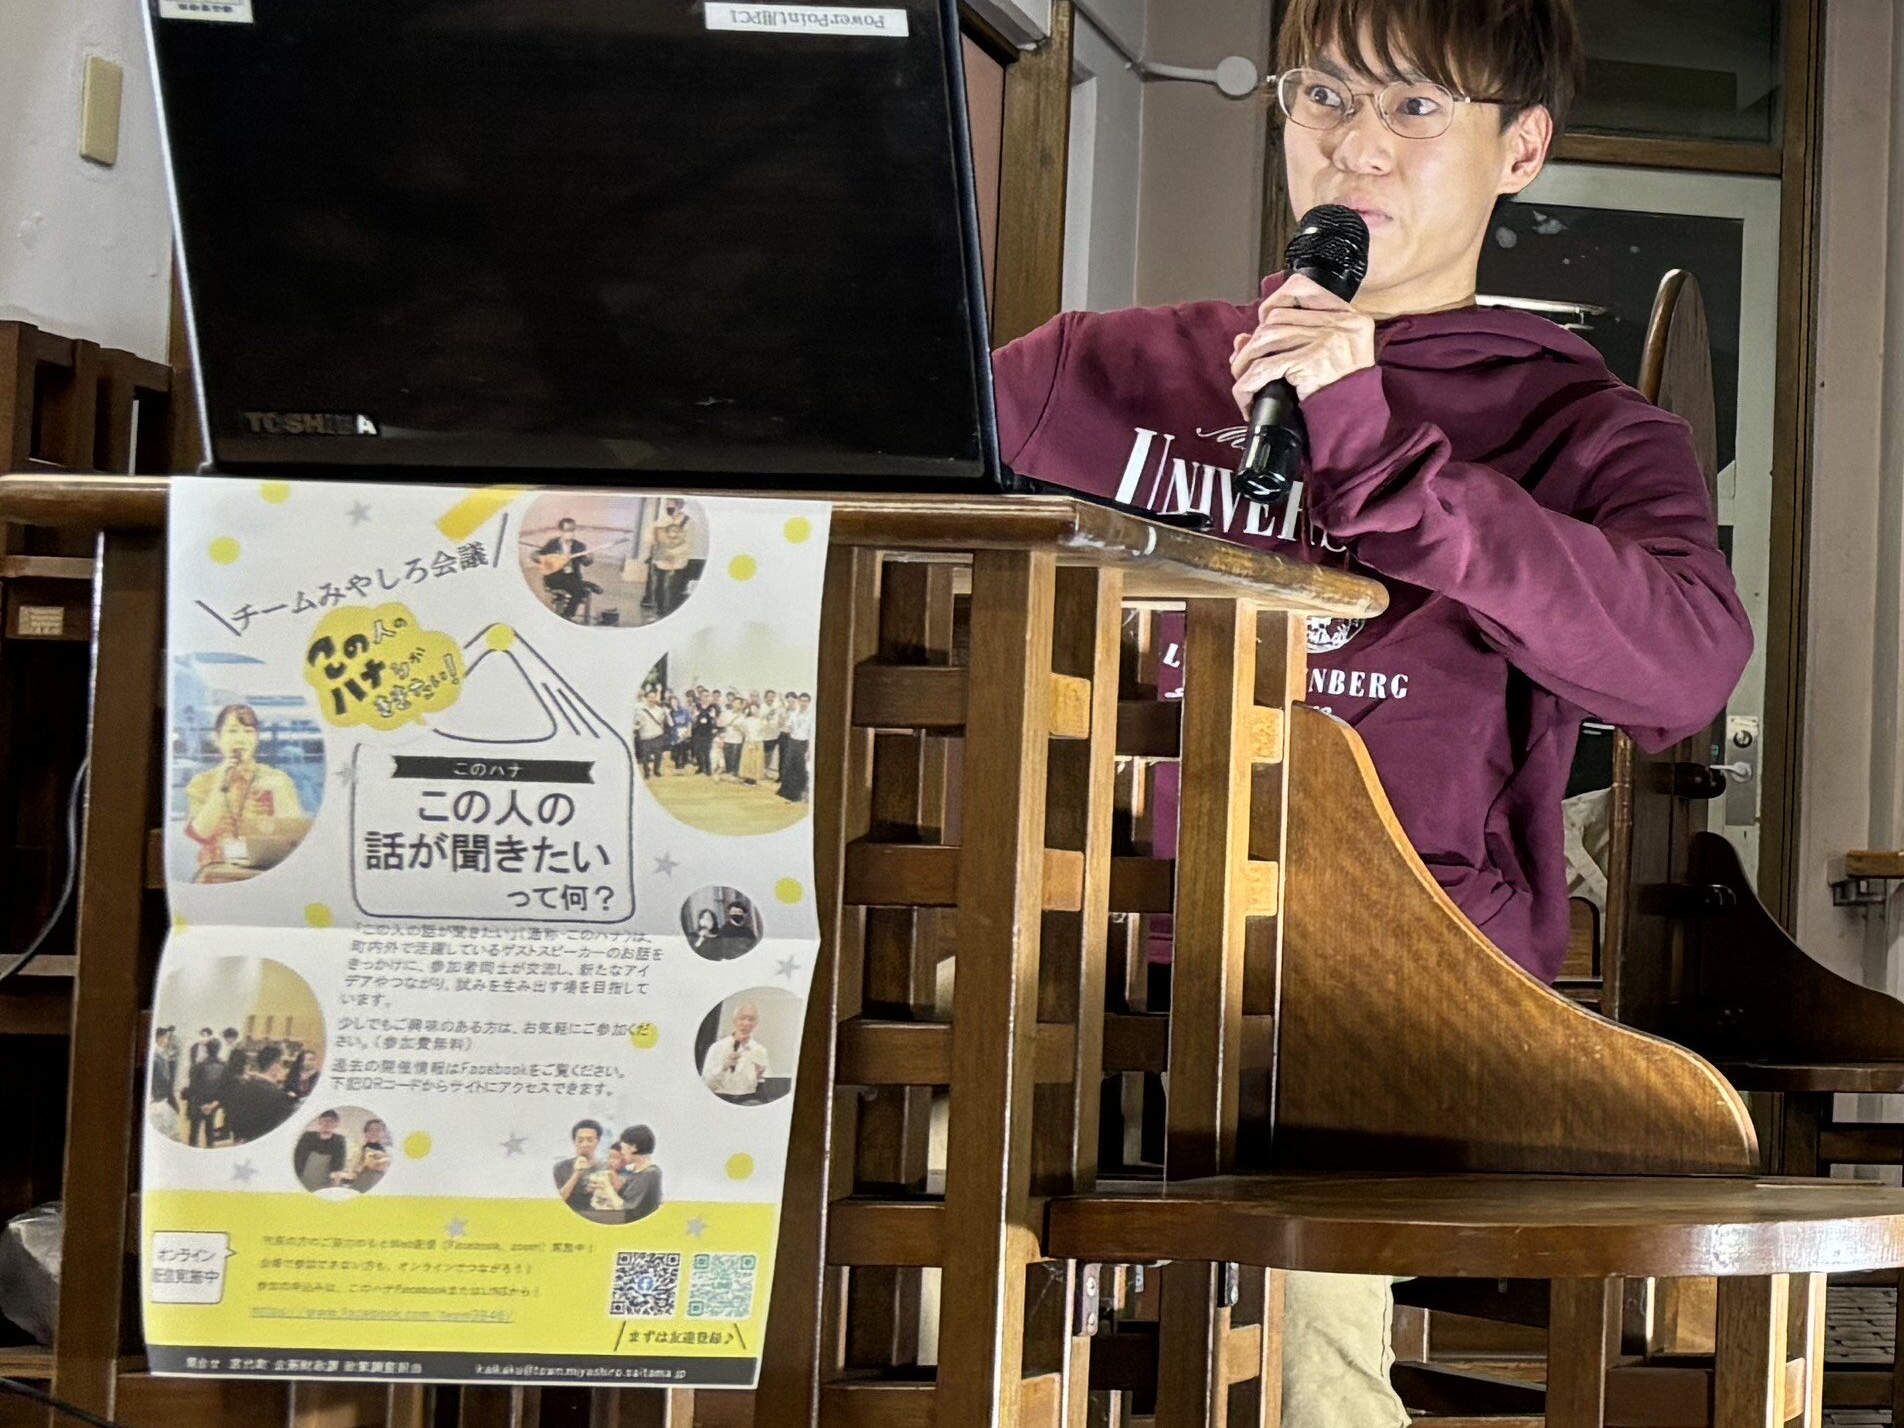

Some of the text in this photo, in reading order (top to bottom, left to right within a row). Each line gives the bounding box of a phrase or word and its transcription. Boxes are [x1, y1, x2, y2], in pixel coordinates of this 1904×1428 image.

[231, 541, 489, 631] チームみやしろ会議
[454, 762, 523, 778] このハナ
[419, 789, 576, 826] この人の
[364, 830, 611, 873] 話が聞きたい
